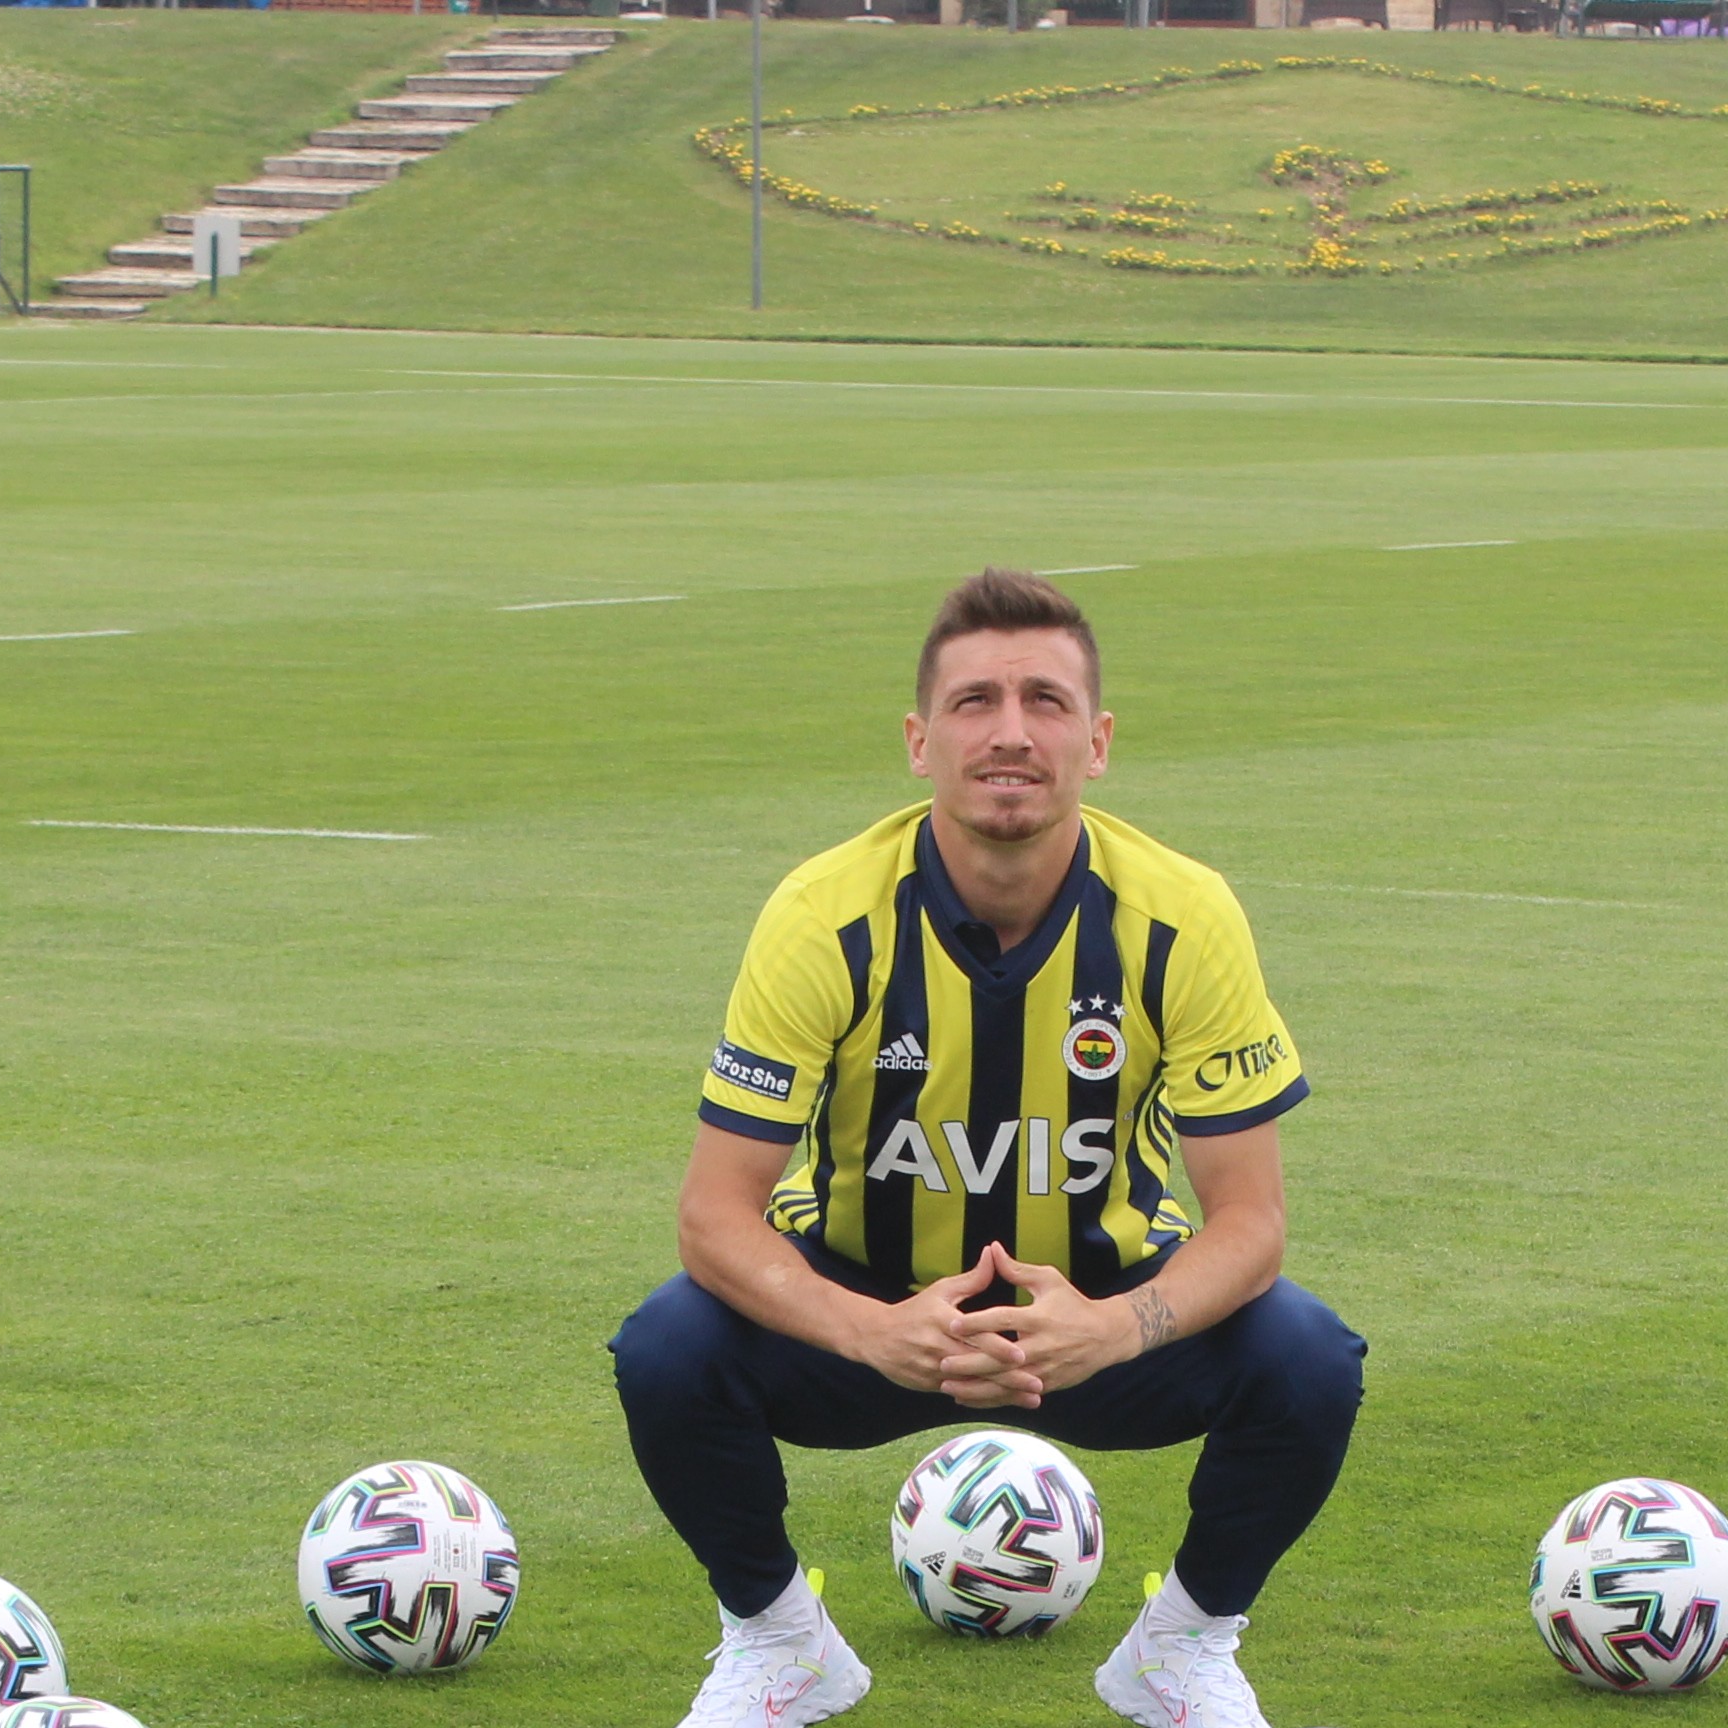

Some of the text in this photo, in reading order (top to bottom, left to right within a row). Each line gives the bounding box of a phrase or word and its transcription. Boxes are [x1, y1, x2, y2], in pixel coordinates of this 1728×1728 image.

[872, 1055, 933, 1071] adidas
[865, 1117, 1116, 1196] AVIS
[920, 1550, 947, 1564] adidas
[1559, 1568, 1580, 1599] adidas
